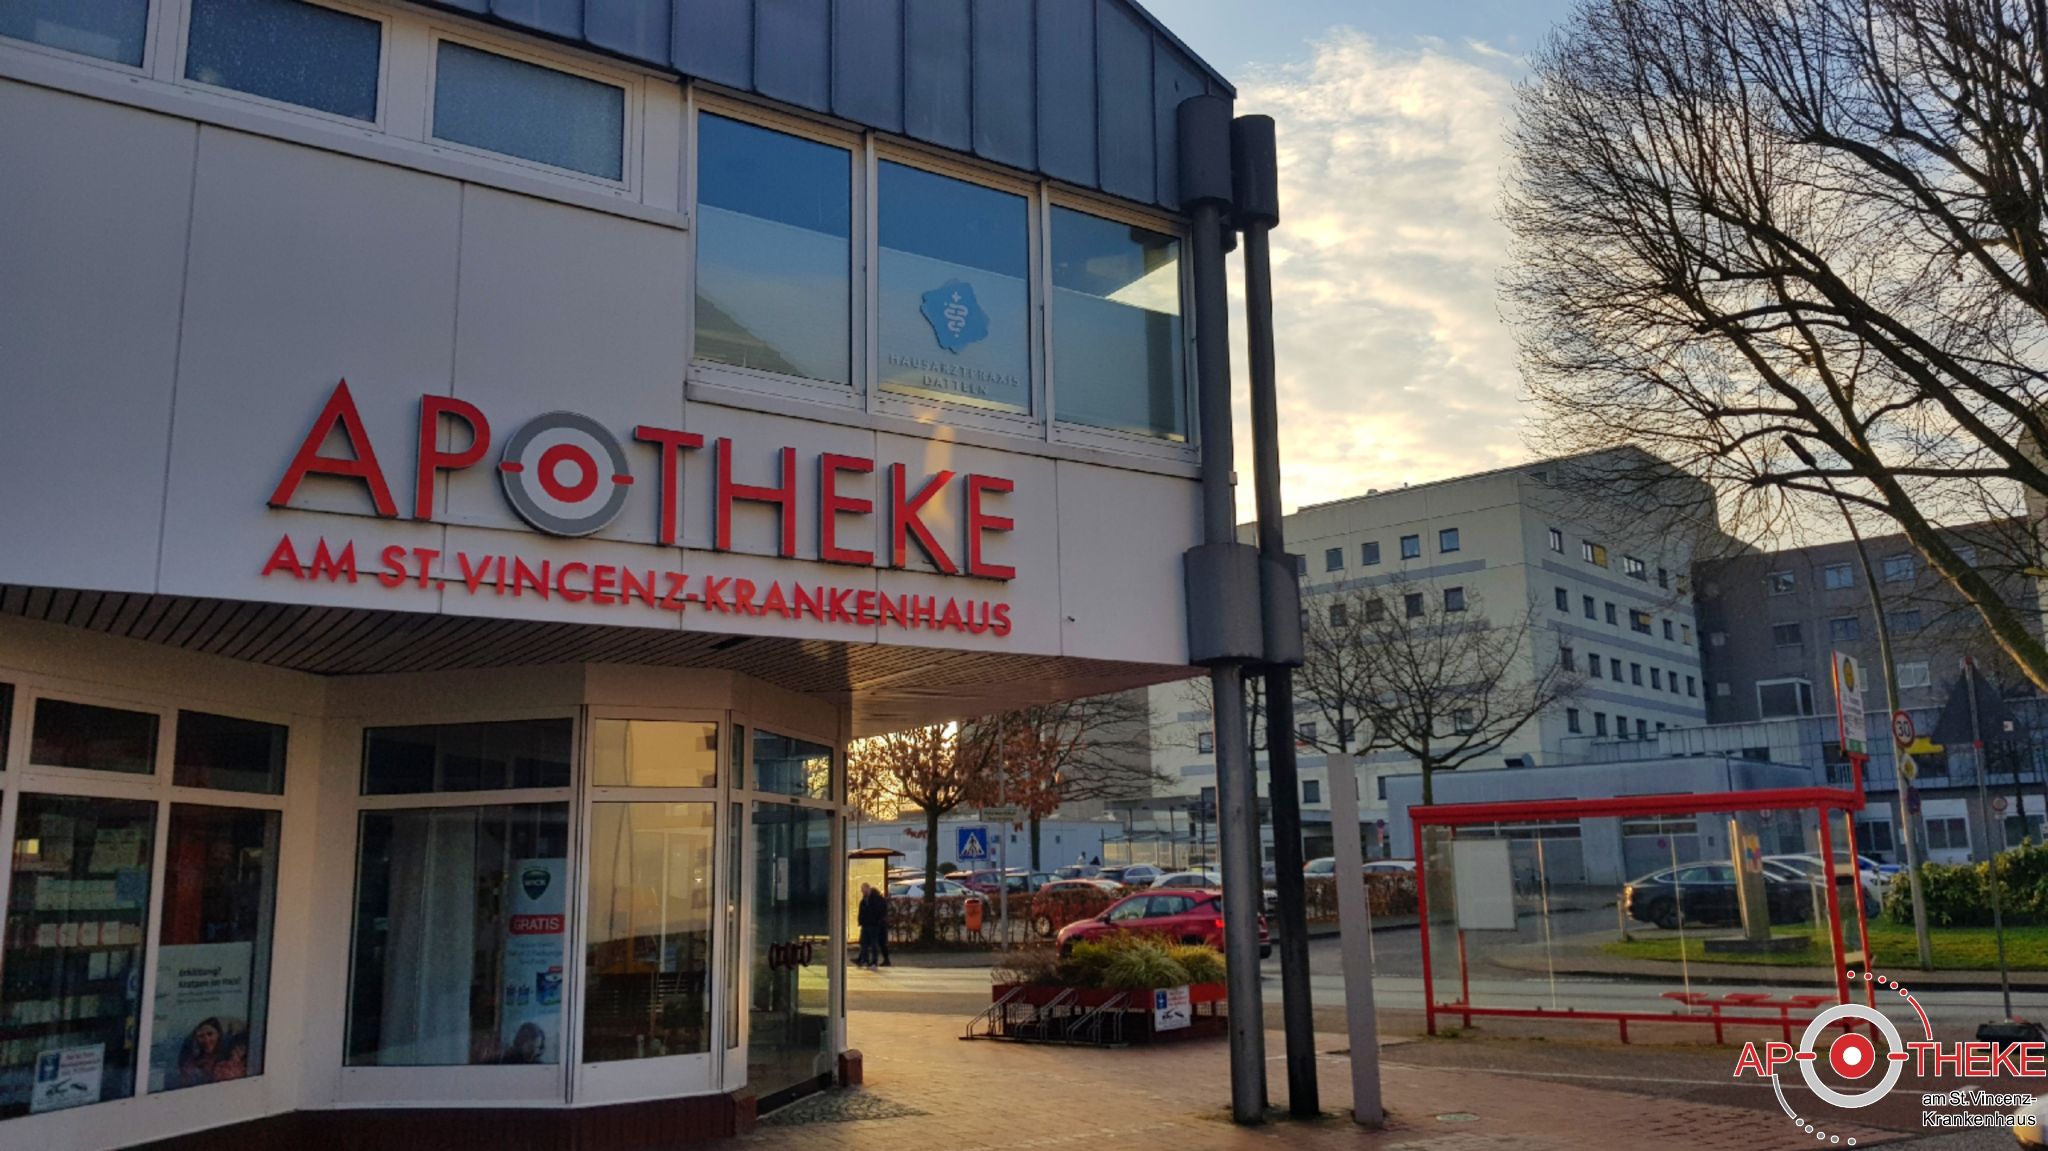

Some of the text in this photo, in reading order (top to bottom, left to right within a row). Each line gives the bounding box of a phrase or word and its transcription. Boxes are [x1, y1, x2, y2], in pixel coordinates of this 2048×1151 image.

[888, 353, 1020, 388] HAUSARZTPRAXIS
[922, 375, 987, 396] DATTELN
[261, 533, 358, 583] AM
[1897, 720, 1911, 738] 30
[513, 917, 560, 931] GRATIS
